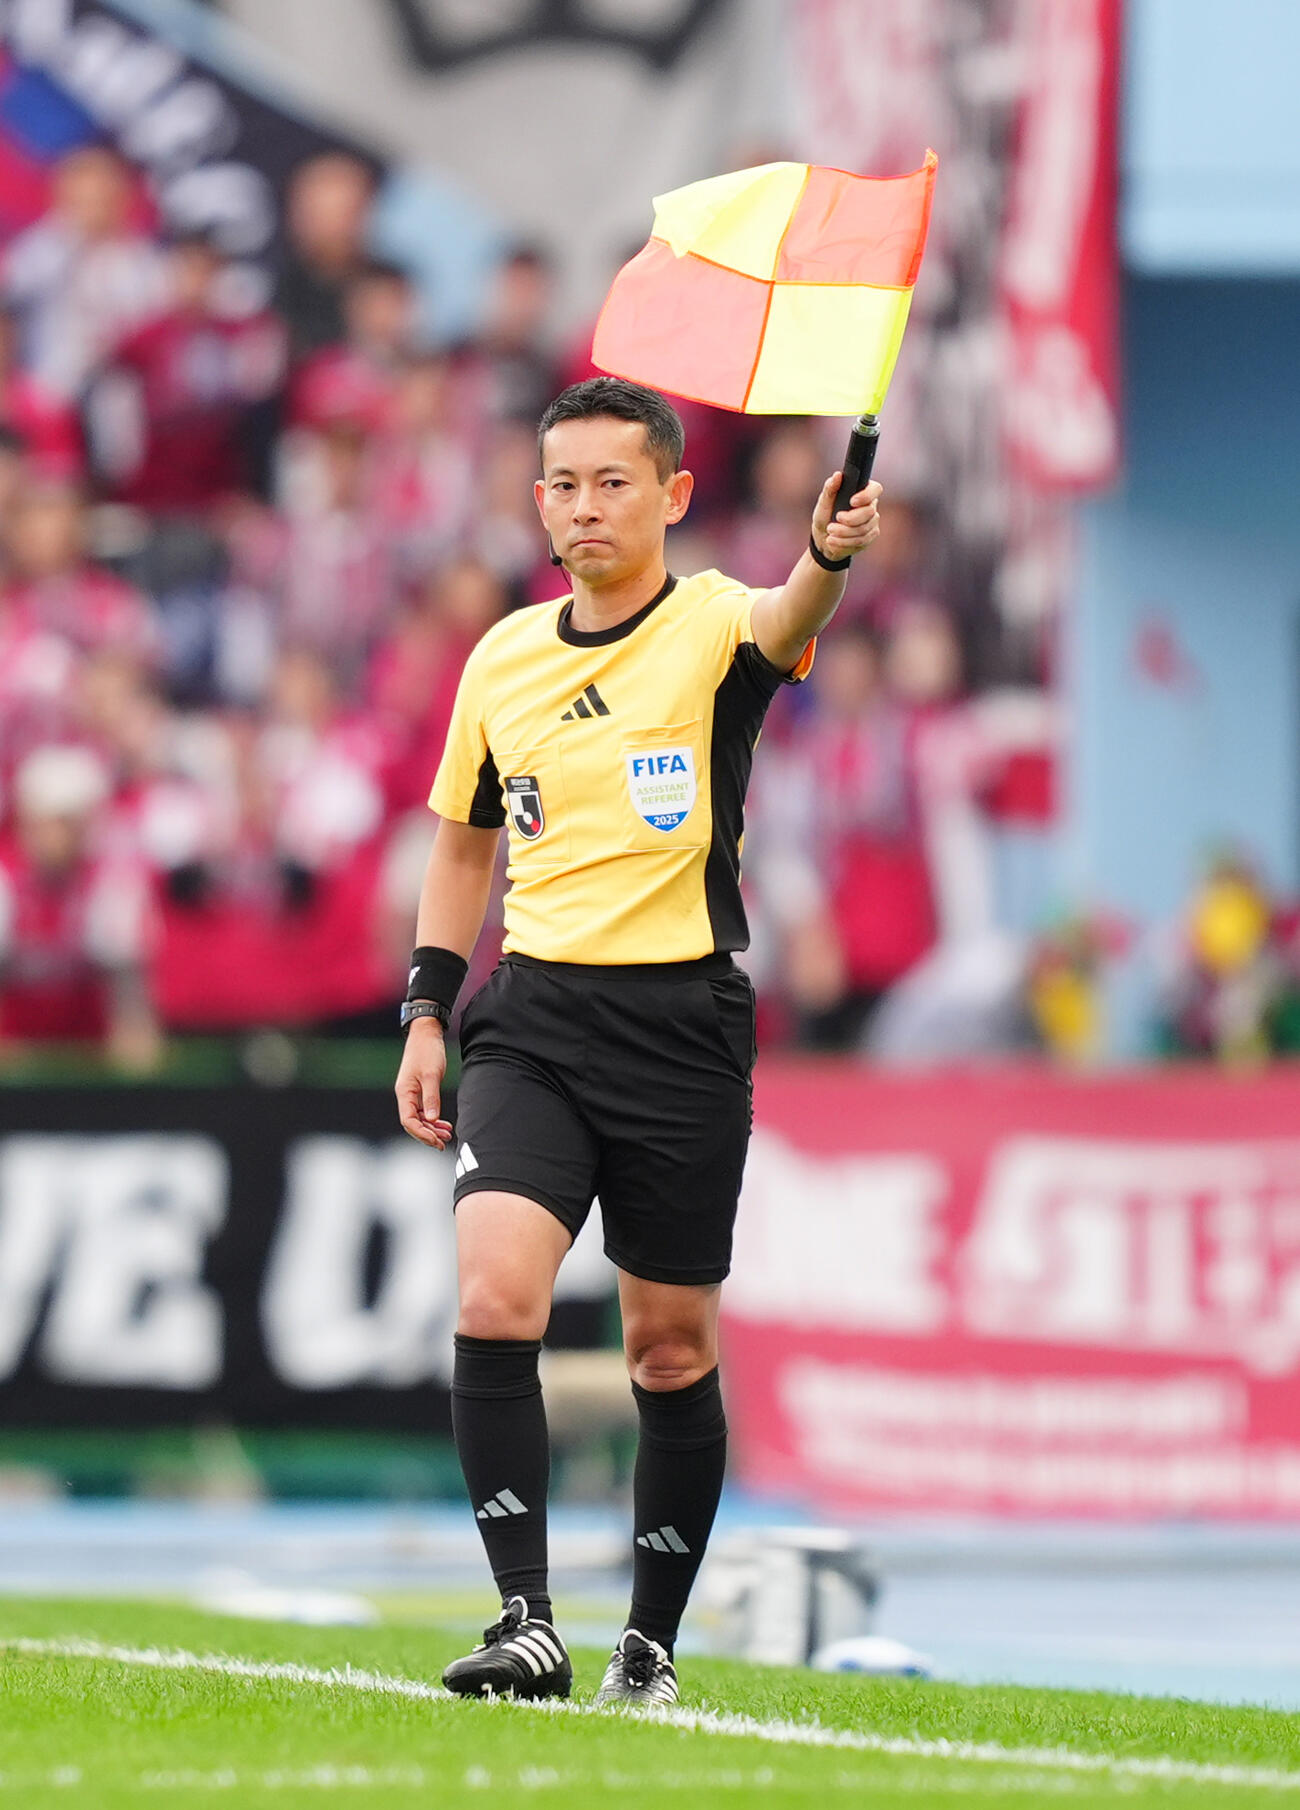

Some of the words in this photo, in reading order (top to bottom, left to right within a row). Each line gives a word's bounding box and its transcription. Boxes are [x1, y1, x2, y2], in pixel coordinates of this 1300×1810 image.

[632, 754, 688, 777] FIFA
[636, 782, 689, 796] ASSISTANT
[641, 791, 687, 805] REFEREE
[653, 814, 680, 826] 2025
